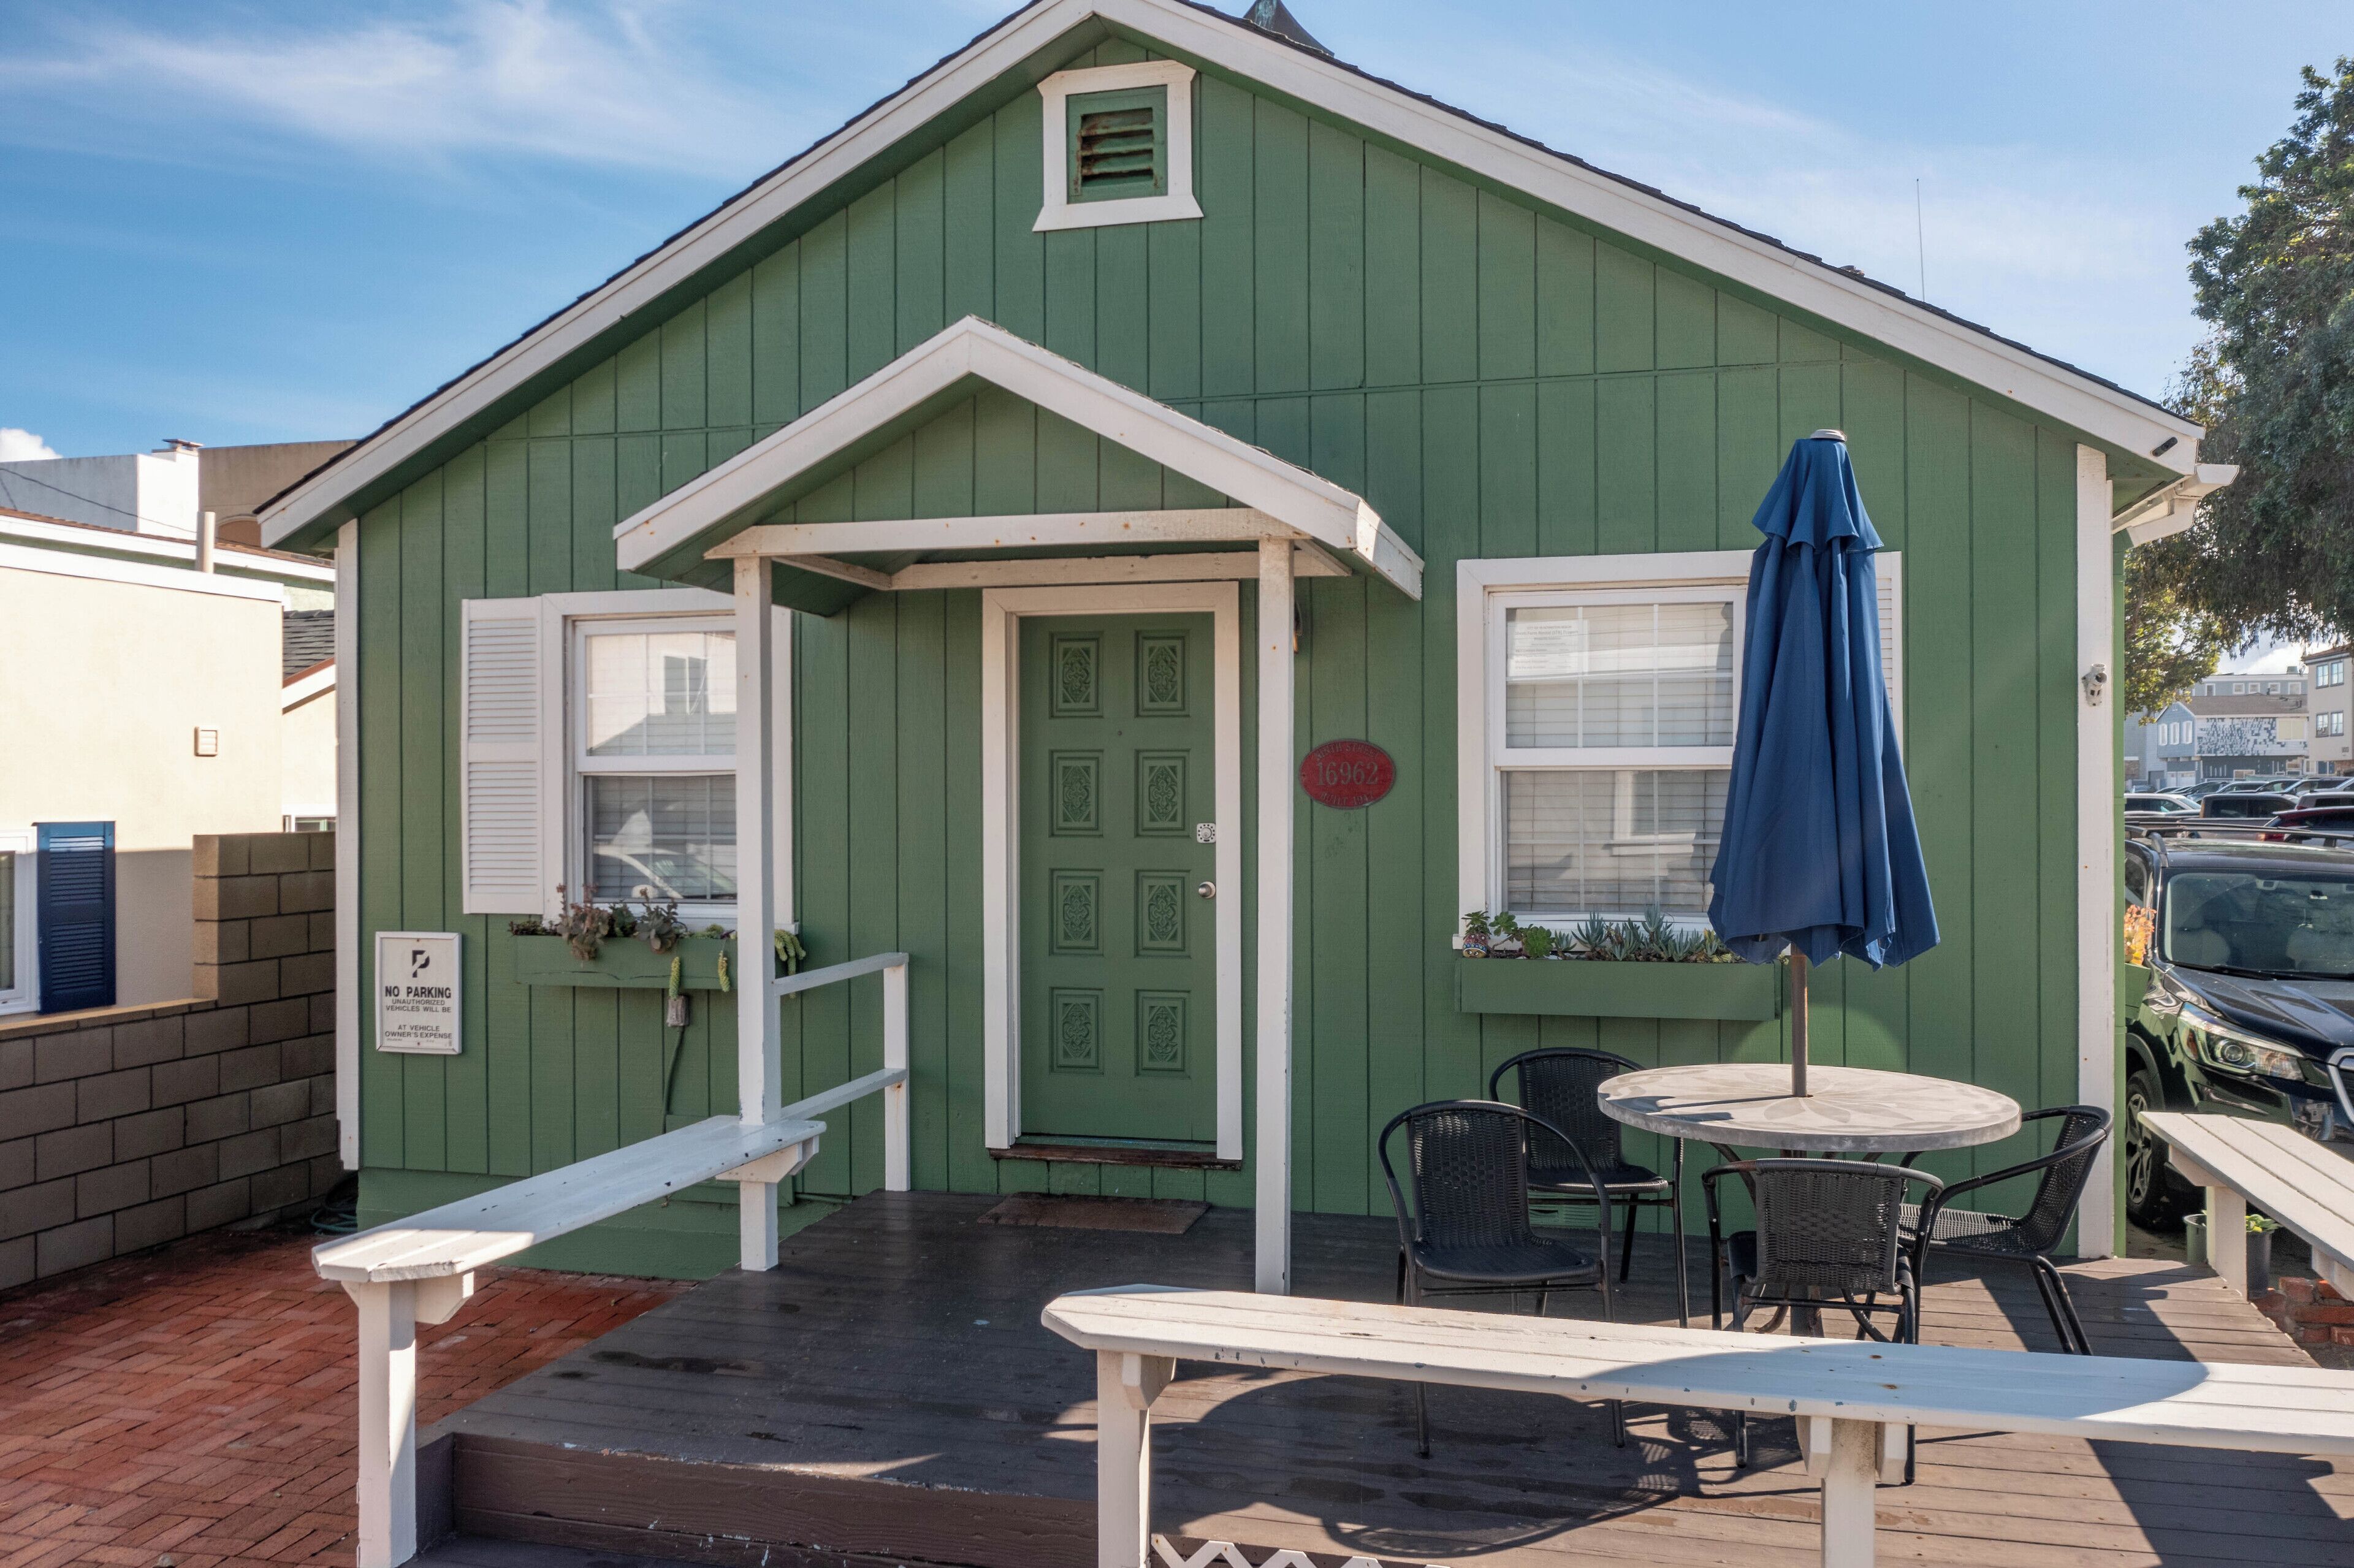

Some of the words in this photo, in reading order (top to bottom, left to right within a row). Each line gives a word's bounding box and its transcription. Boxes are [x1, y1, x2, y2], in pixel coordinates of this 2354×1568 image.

[1316, 761, 1378, 786] 16962
[385, 986, 400, 997] NO
[406, 986, 452, 999] PARKING
